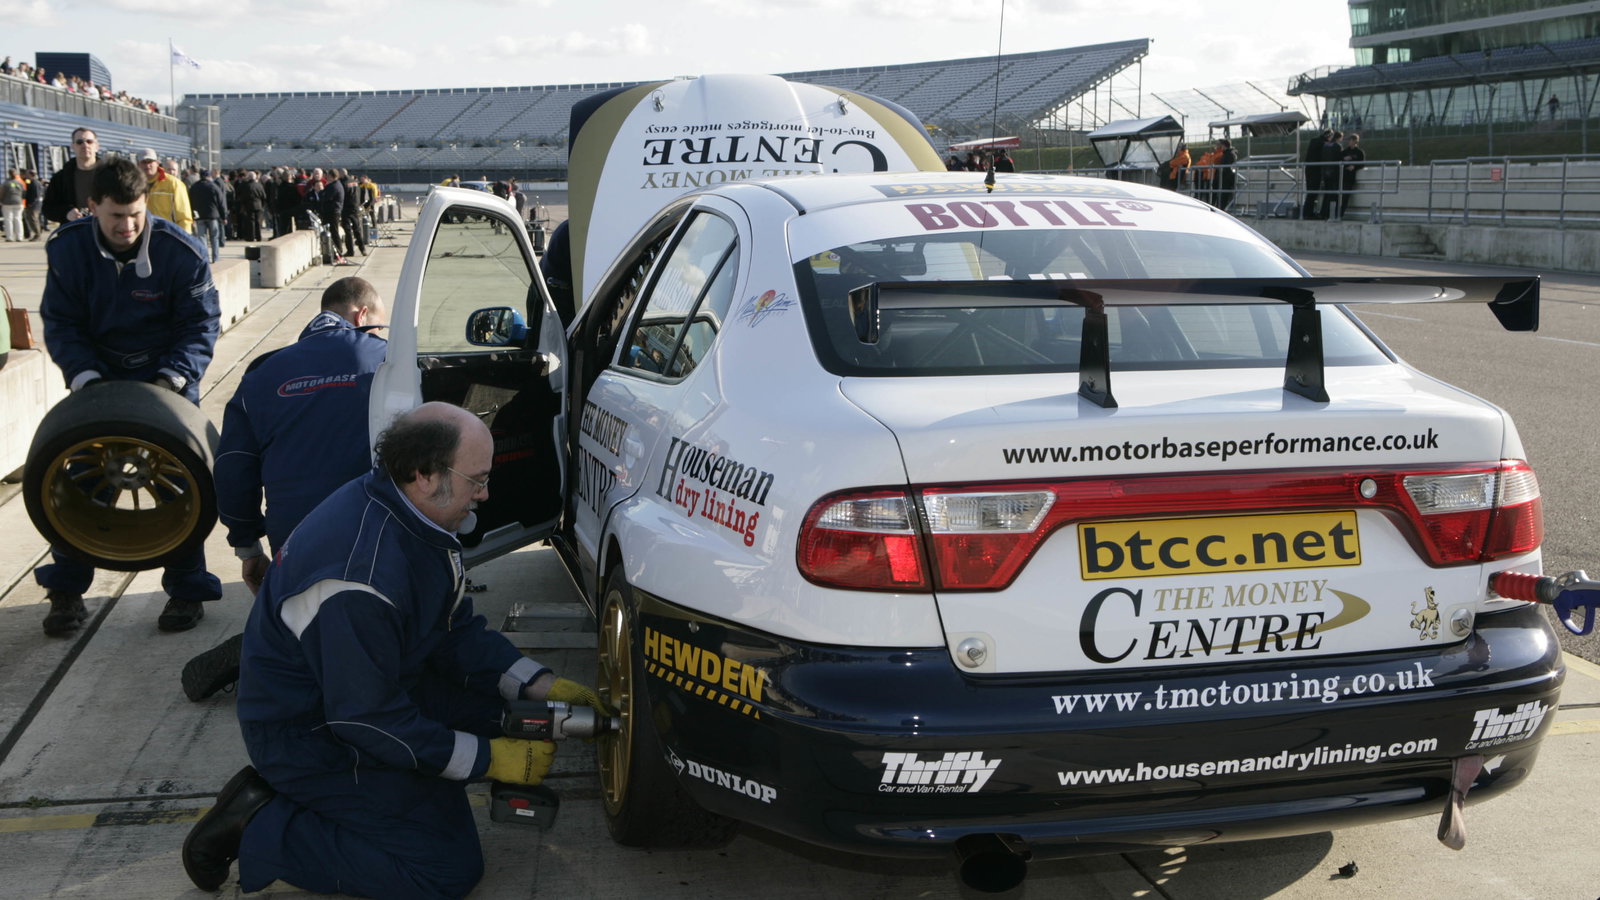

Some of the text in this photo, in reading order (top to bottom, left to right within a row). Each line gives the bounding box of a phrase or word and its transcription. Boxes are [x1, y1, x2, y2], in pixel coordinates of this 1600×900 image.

[645, 123, 678, 135] easy
[682, 123, 722, 136] made
[727, 120, 802, 133] mortgages
[904, 200, 1138, 231] BOTTLE
[285, 373, 358, 392] MOTORBASE
[592, 406, 629, 457] MONEY
[1002, 427, 1440, 464] www.motorbaseperformance.co.uk
[655, 436, 775, 507] Houseman
[675, 478, 760, 547] dry lining
[1083, 519, 1357, 574] btcc.net
[1152, 578, 1329, 612] THE MONEY
[1078, 586, 1326, 664] CENTRE
[644, 626, 767, 702] HEWDEN
[1051, 661, 1435, 714] www.tmctouring.co.uk
[1470, 699, 1549, 742] Thrifty
[1057, 737, 1439, 786] www.housemandrylining.com
[1464, 741, 1479, 750] Car
[686, 759, 777, 804] DUNLOP
[878, 783, 968, 793] Car and Van Rental
[880, 751, 1002, 793] Thrifty
